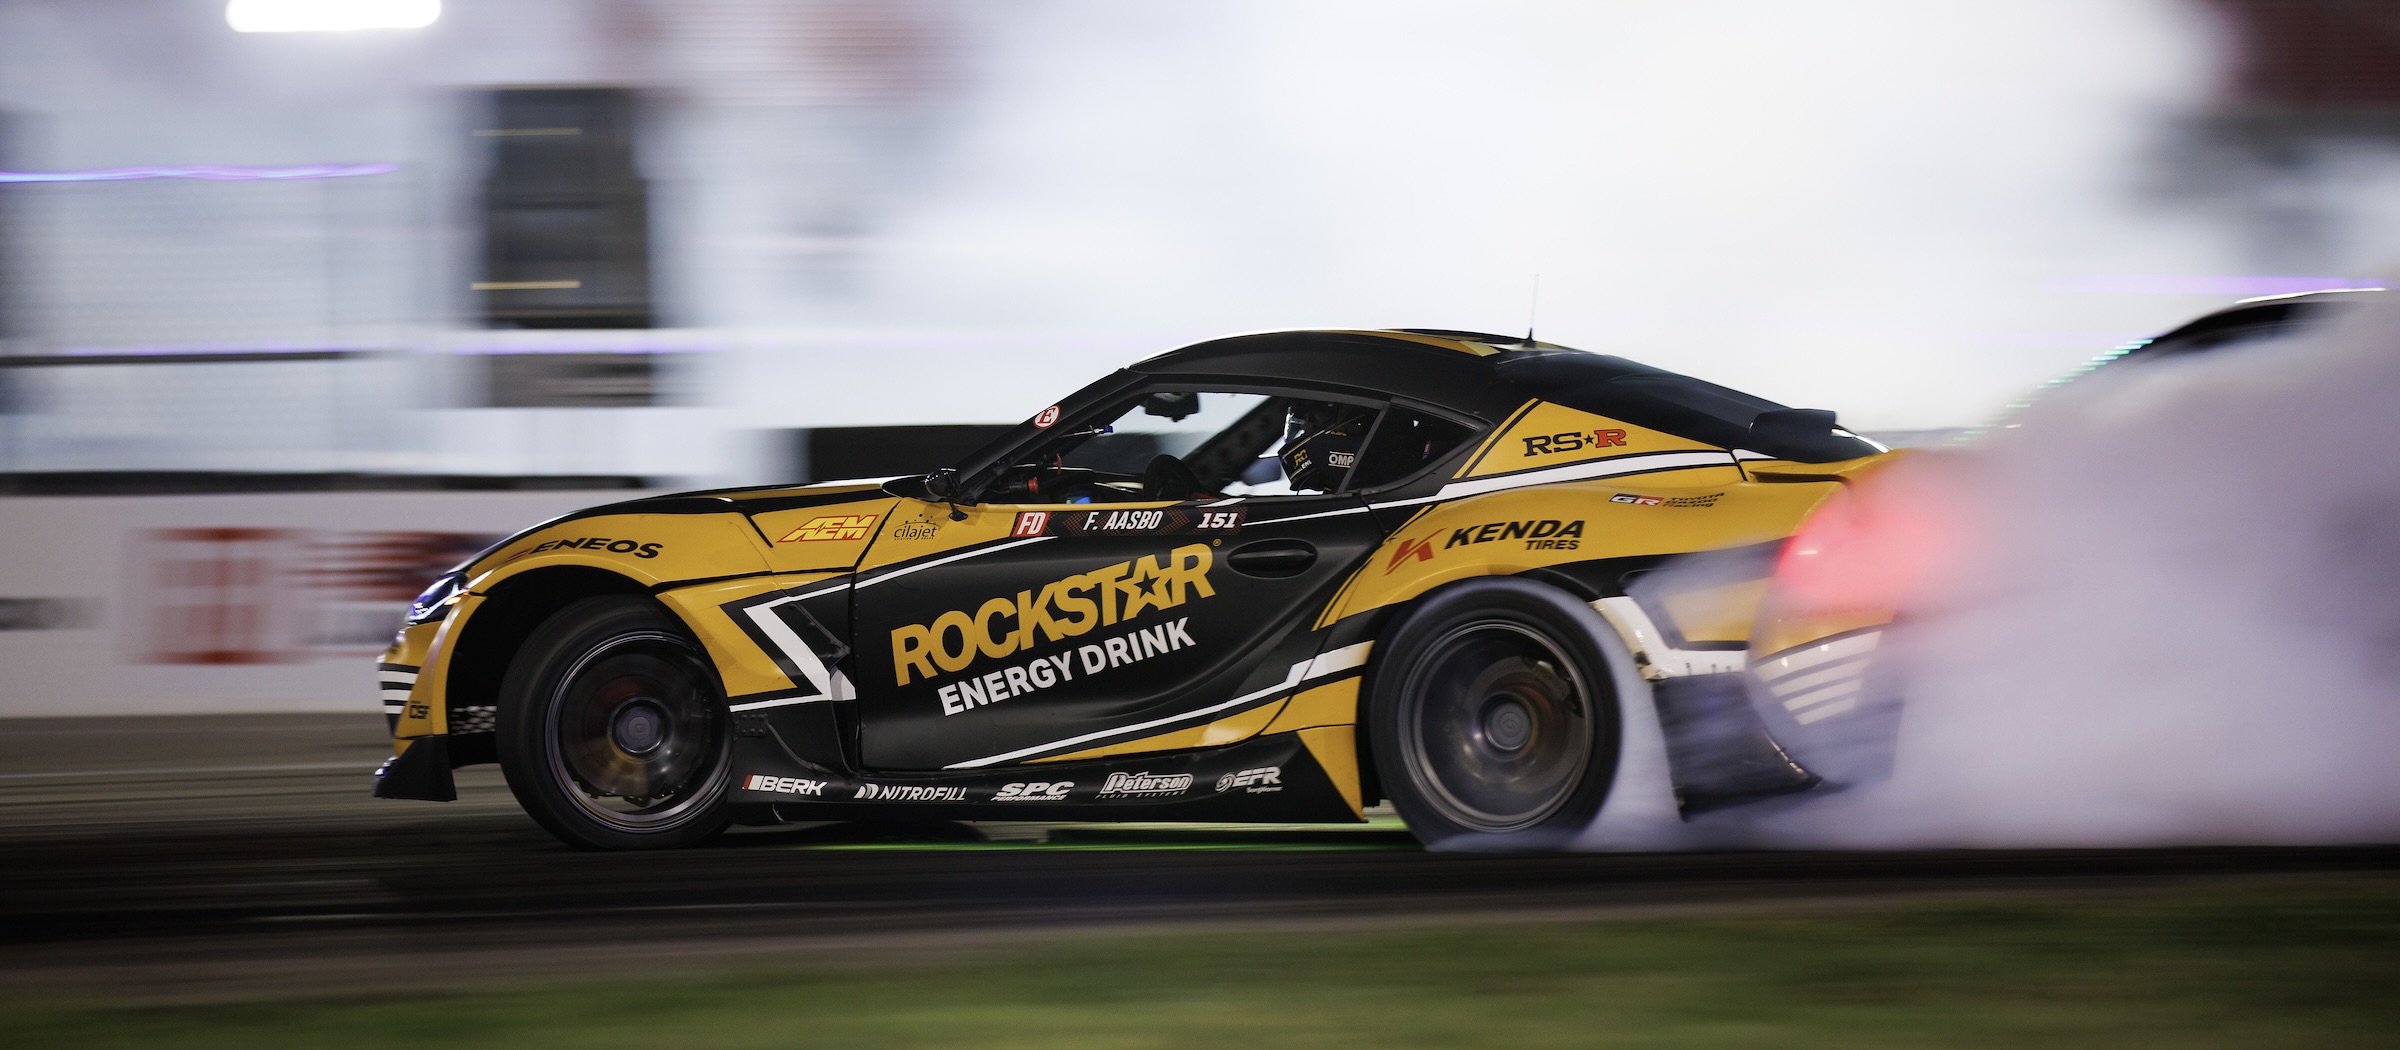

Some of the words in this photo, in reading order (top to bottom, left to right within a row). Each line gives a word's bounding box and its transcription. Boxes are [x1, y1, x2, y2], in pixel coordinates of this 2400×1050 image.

[1328, 452, 1354, 467] OMP
[1610, 496, 1660, 506] GR
[777, 514, 879, 543] AEM
[893, 525, 937, 541] cilajet
[1016, 511, 1046, 535] FD
[1083, 511, 1100, 531] F.
[1103, 510, 1163, 531] AASBO
[1197, 512, 1238, 529] 151
[1444, 519, 1586, 550] KENDA
[1525, 538, 1580, 551] TIRES
[528, 537, 664, 559] ENEOS
[890, 542, 1217, 688] ROCKSTAR
[937, 650, 1074, 717] ENERGY
[1078, 616, 1197, 677] DRINK
[760, 775, 828, 796] BERK
[1100, 771, 1194, 794] Peterson
[1231, 766, 1282, 788] EFR
[877, 785, 968, 801] NITROFILL
[996, 780, 1075, 797] SPC
